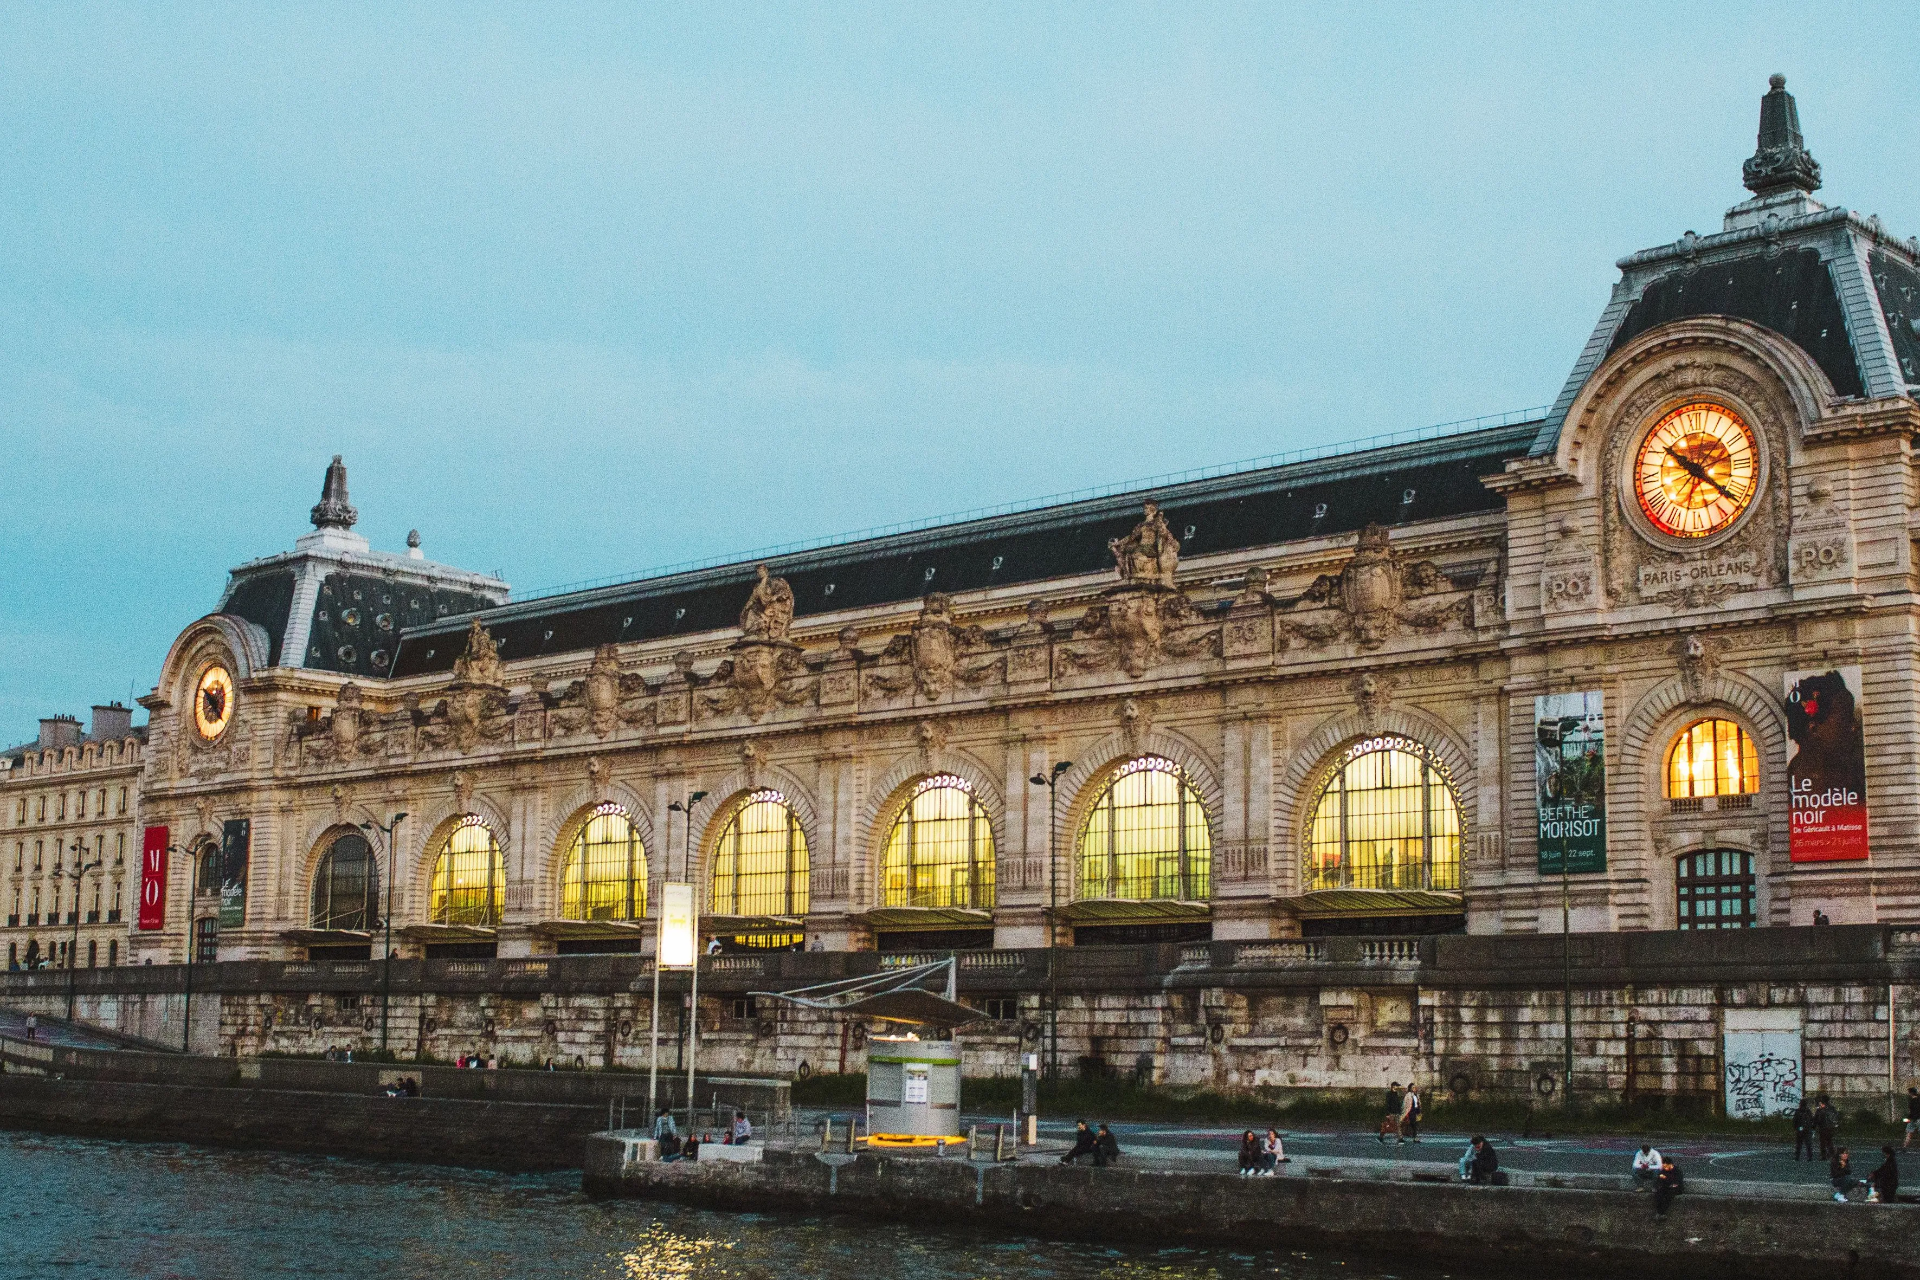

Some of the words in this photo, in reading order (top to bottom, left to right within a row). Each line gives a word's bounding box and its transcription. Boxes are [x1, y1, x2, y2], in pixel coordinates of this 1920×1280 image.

[1801, 546, 1838, 567] PO
[1643, 562, 1751, 585] PARIS-ORLEANS
[1553, 579, 1582, 596] PO
[1791, 775, 1812, 793] Le
[1791, 787, 1858, 809] modèle
[1792, 808, 1826, 825] noir
[1540, 818, 1601, 839] MORISOT
[1793, 826, 1801, 834] De
[1794, 839, 1804, 848] 26
[148, 849, 160, 872] M
[1568, 849, 1577, 858] 22
